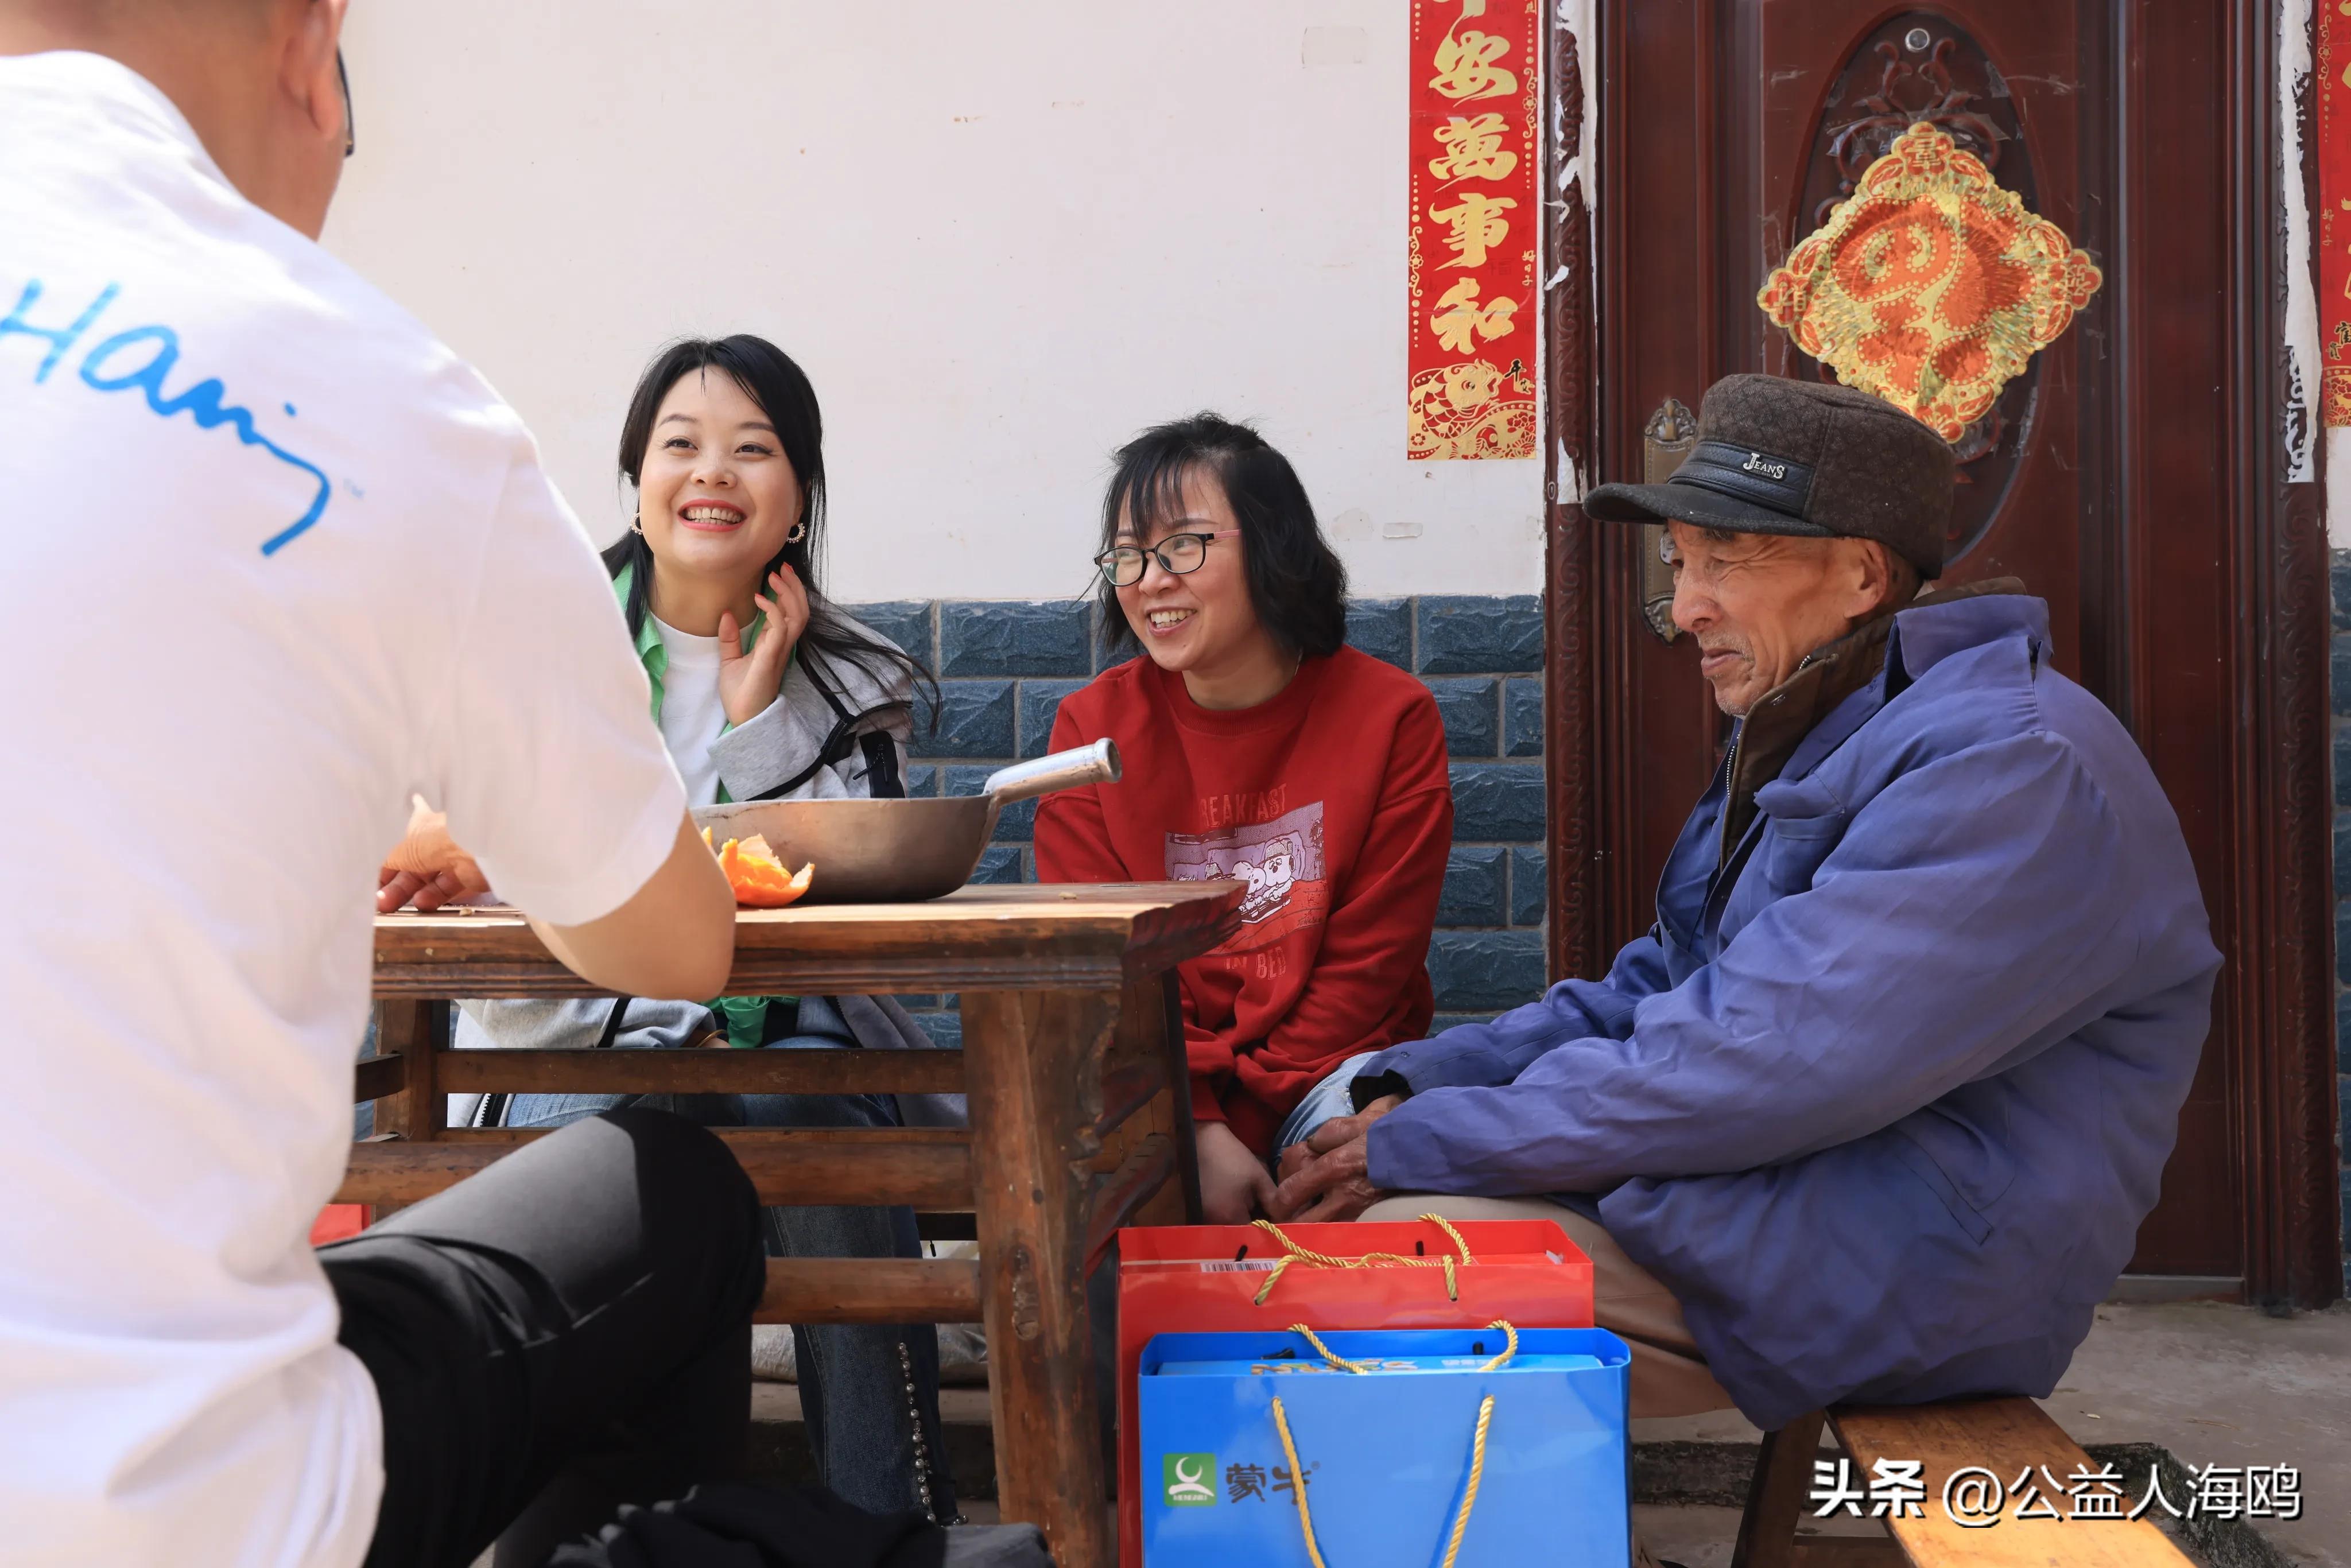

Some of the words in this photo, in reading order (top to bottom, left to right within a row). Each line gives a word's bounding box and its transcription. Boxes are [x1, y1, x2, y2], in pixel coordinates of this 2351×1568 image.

[1428, 0, 1518, 355] 安萬事和
[1522, 250, 1537, 286] 好日子
[1830, 193, 2036, 397] 福
[1743, 452, 1785, 479] JEANS
[1198, 783, 1287, 828] REAKFAST
[1255, 946, 1286, 980] BED
[1226, 1462, 1312, 1505] 蒙牛
